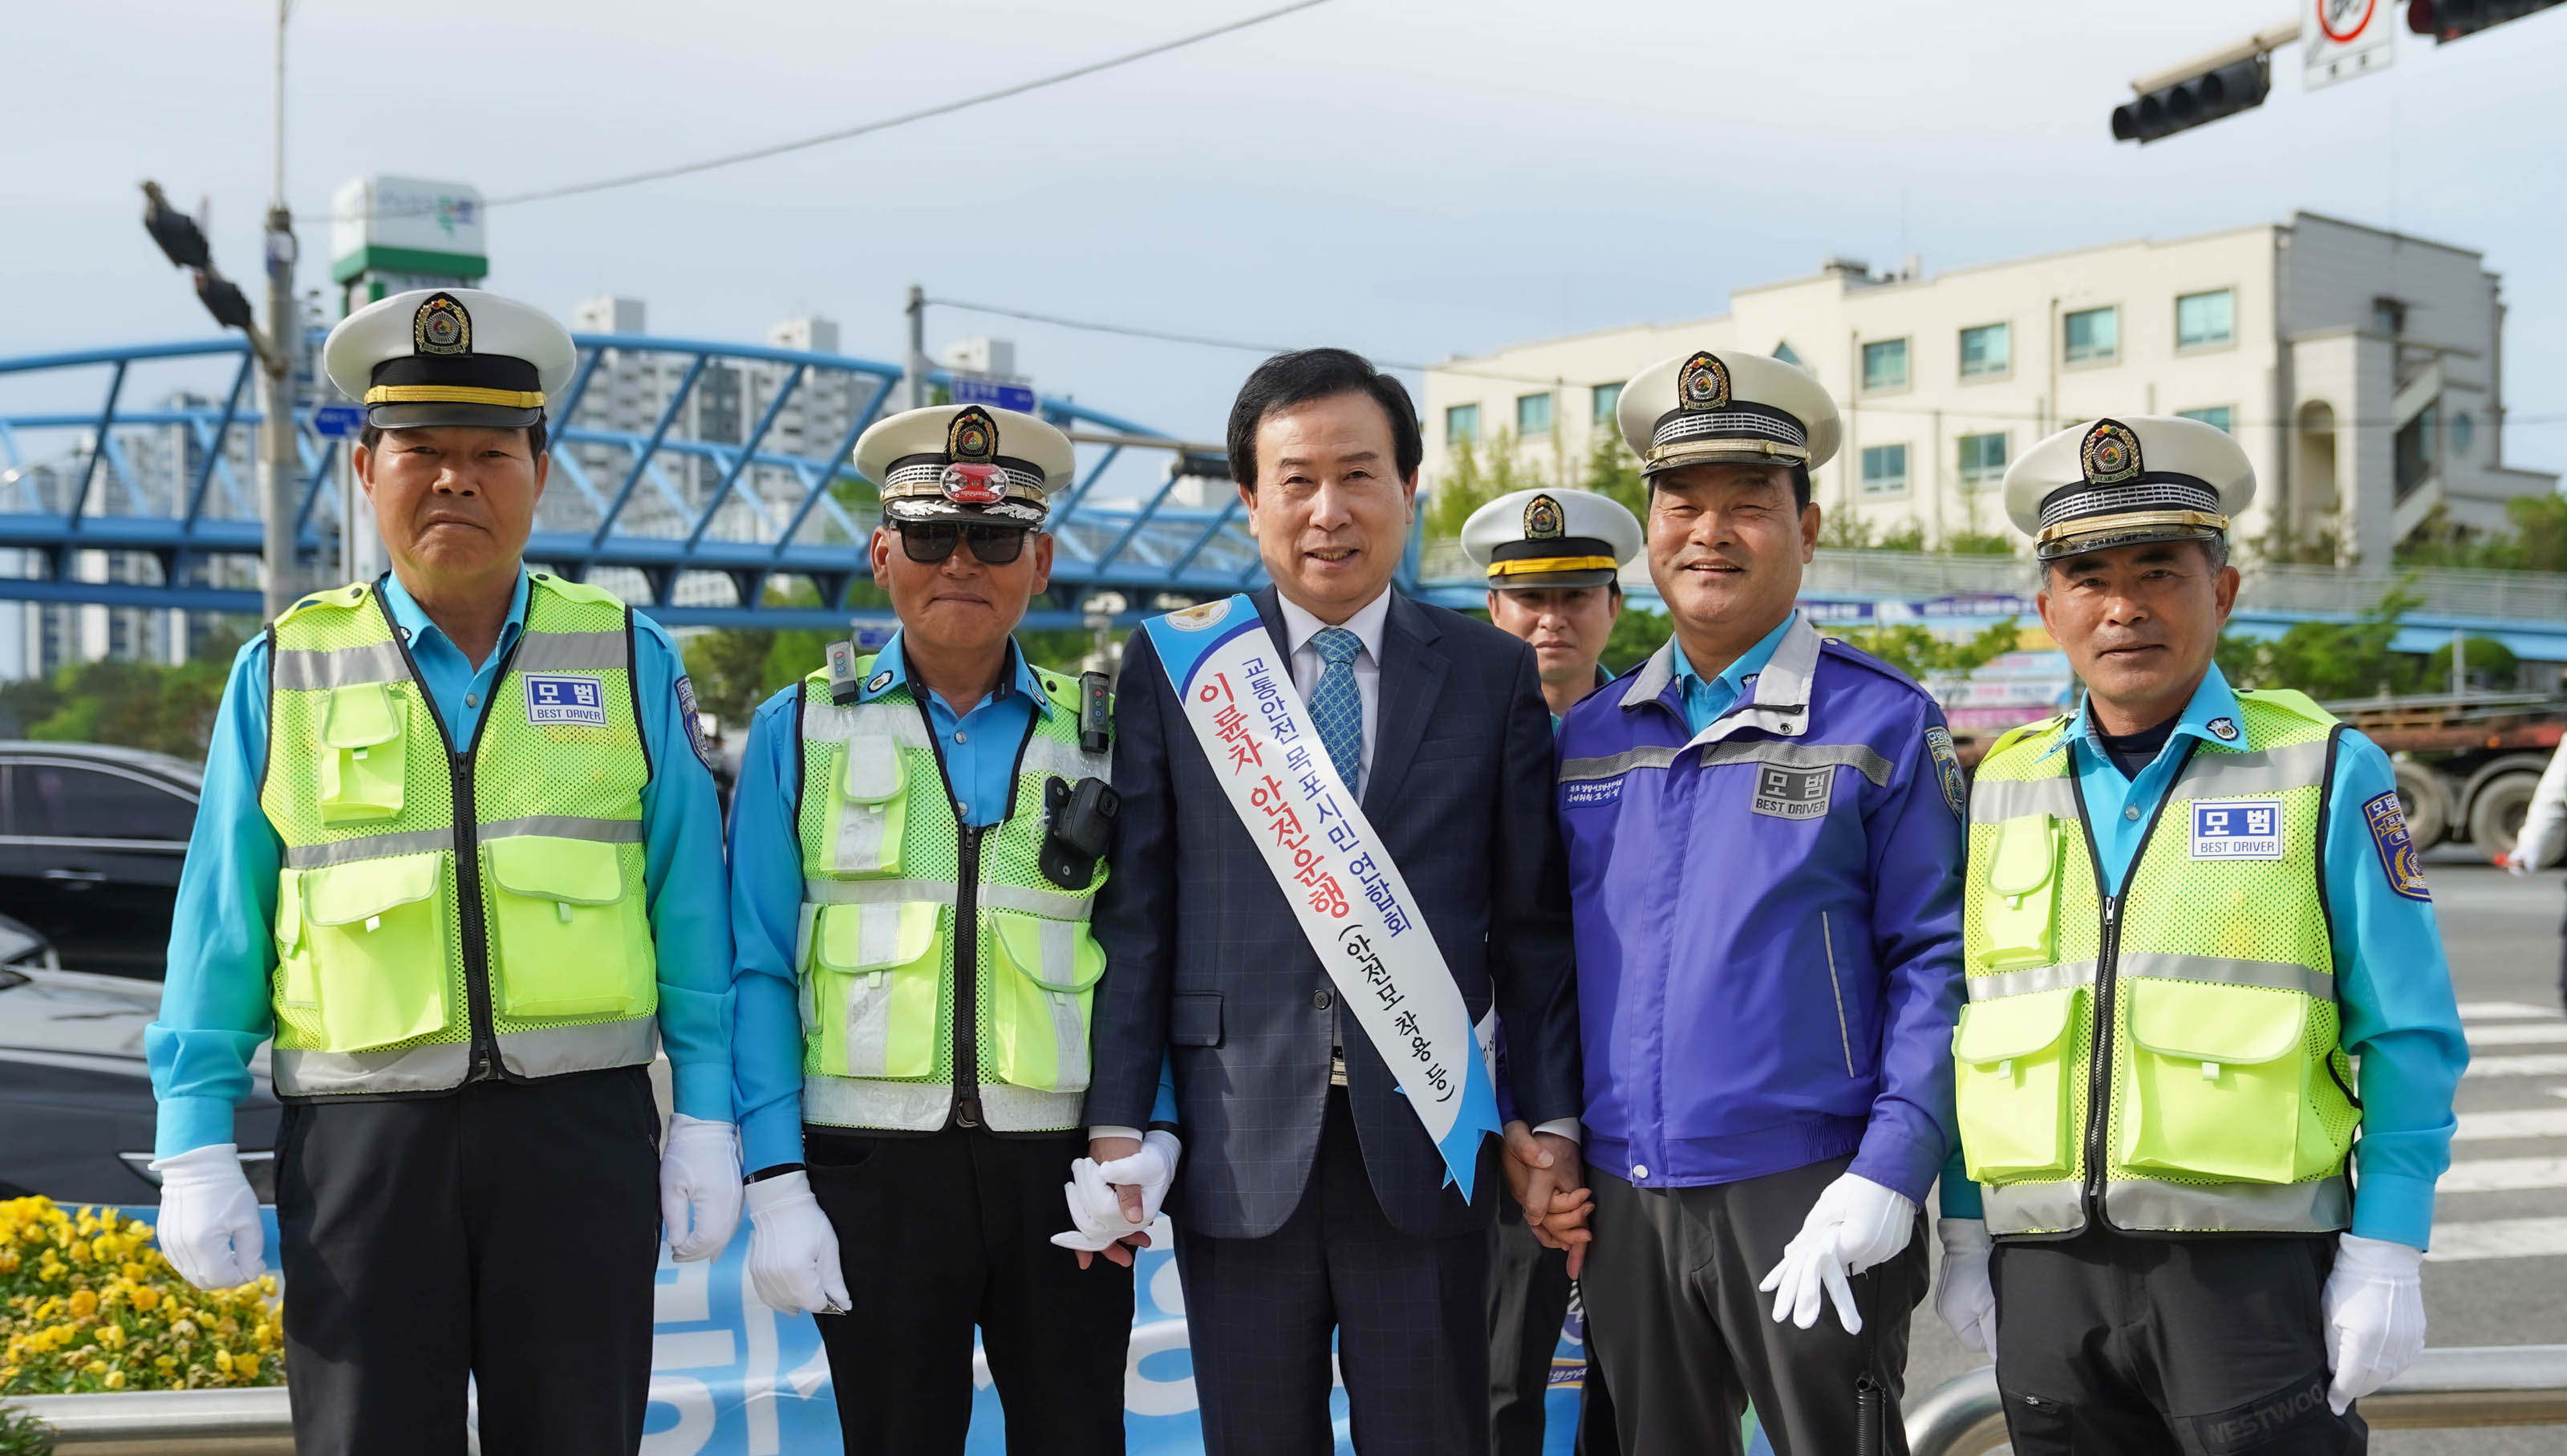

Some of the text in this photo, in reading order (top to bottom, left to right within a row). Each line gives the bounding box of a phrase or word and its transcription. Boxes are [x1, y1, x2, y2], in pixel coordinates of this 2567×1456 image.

[1242, 657, 1300, 745] 교통안전
[537, 709, 601, 720] BEST DRIVER
[1756, 798, 1826, 814] BEST DRIVER
[2372, 796, 2401, 816] 모범
[2200, 842, 2274, 853] BEST DRIVER
[1200, 672, 1263, 776] 이륜차
[1251, 775, 1349, 919] 안전운행
[1338, 924, 1405, 1011] (안전모
[1394, 1010, 1431, 1062] 착용
[1425, 1063, 1455, 1102] 등)
